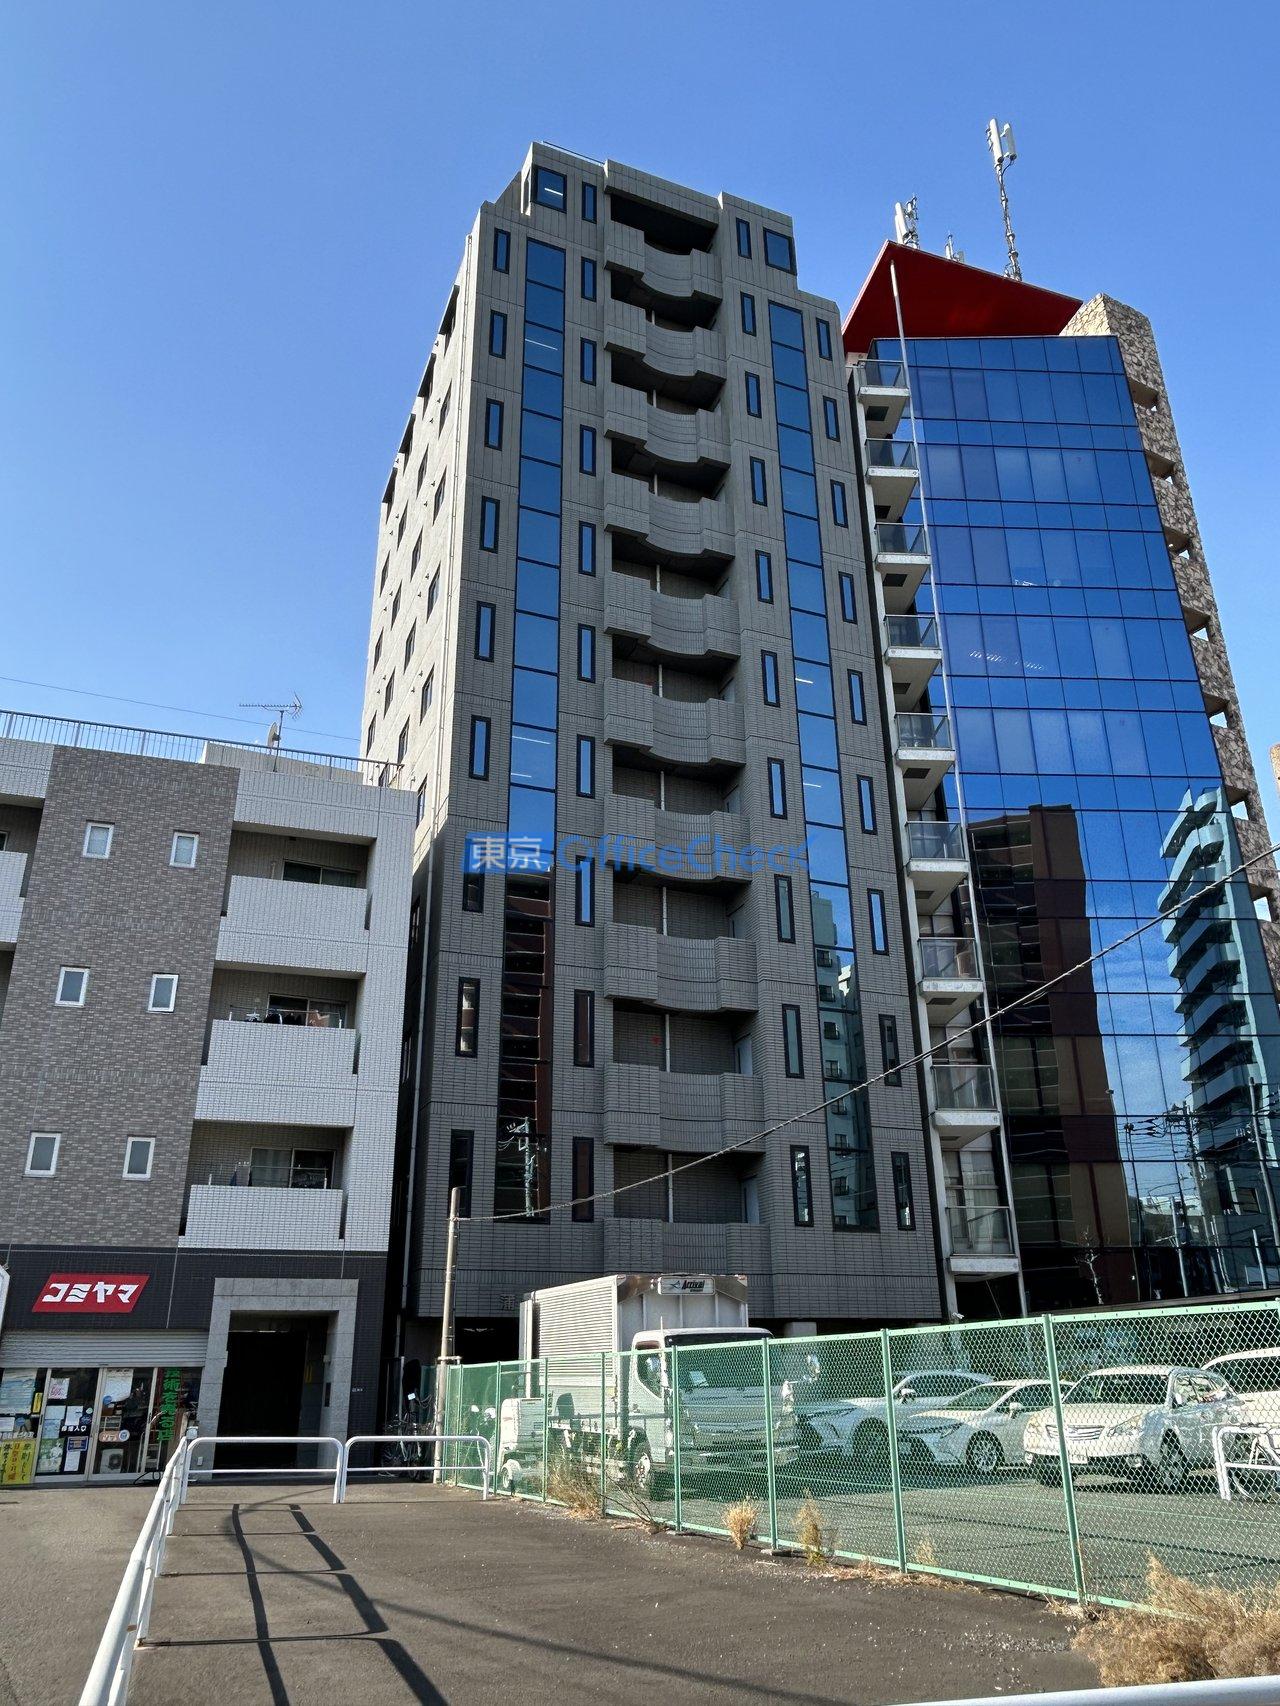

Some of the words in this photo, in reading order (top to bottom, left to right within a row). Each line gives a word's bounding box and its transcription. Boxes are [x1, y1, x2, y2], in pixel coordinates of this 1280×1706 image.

[41, 1281, 139, 1303] コミヤマ
[682, 1280, 706, 1290] Arrival
